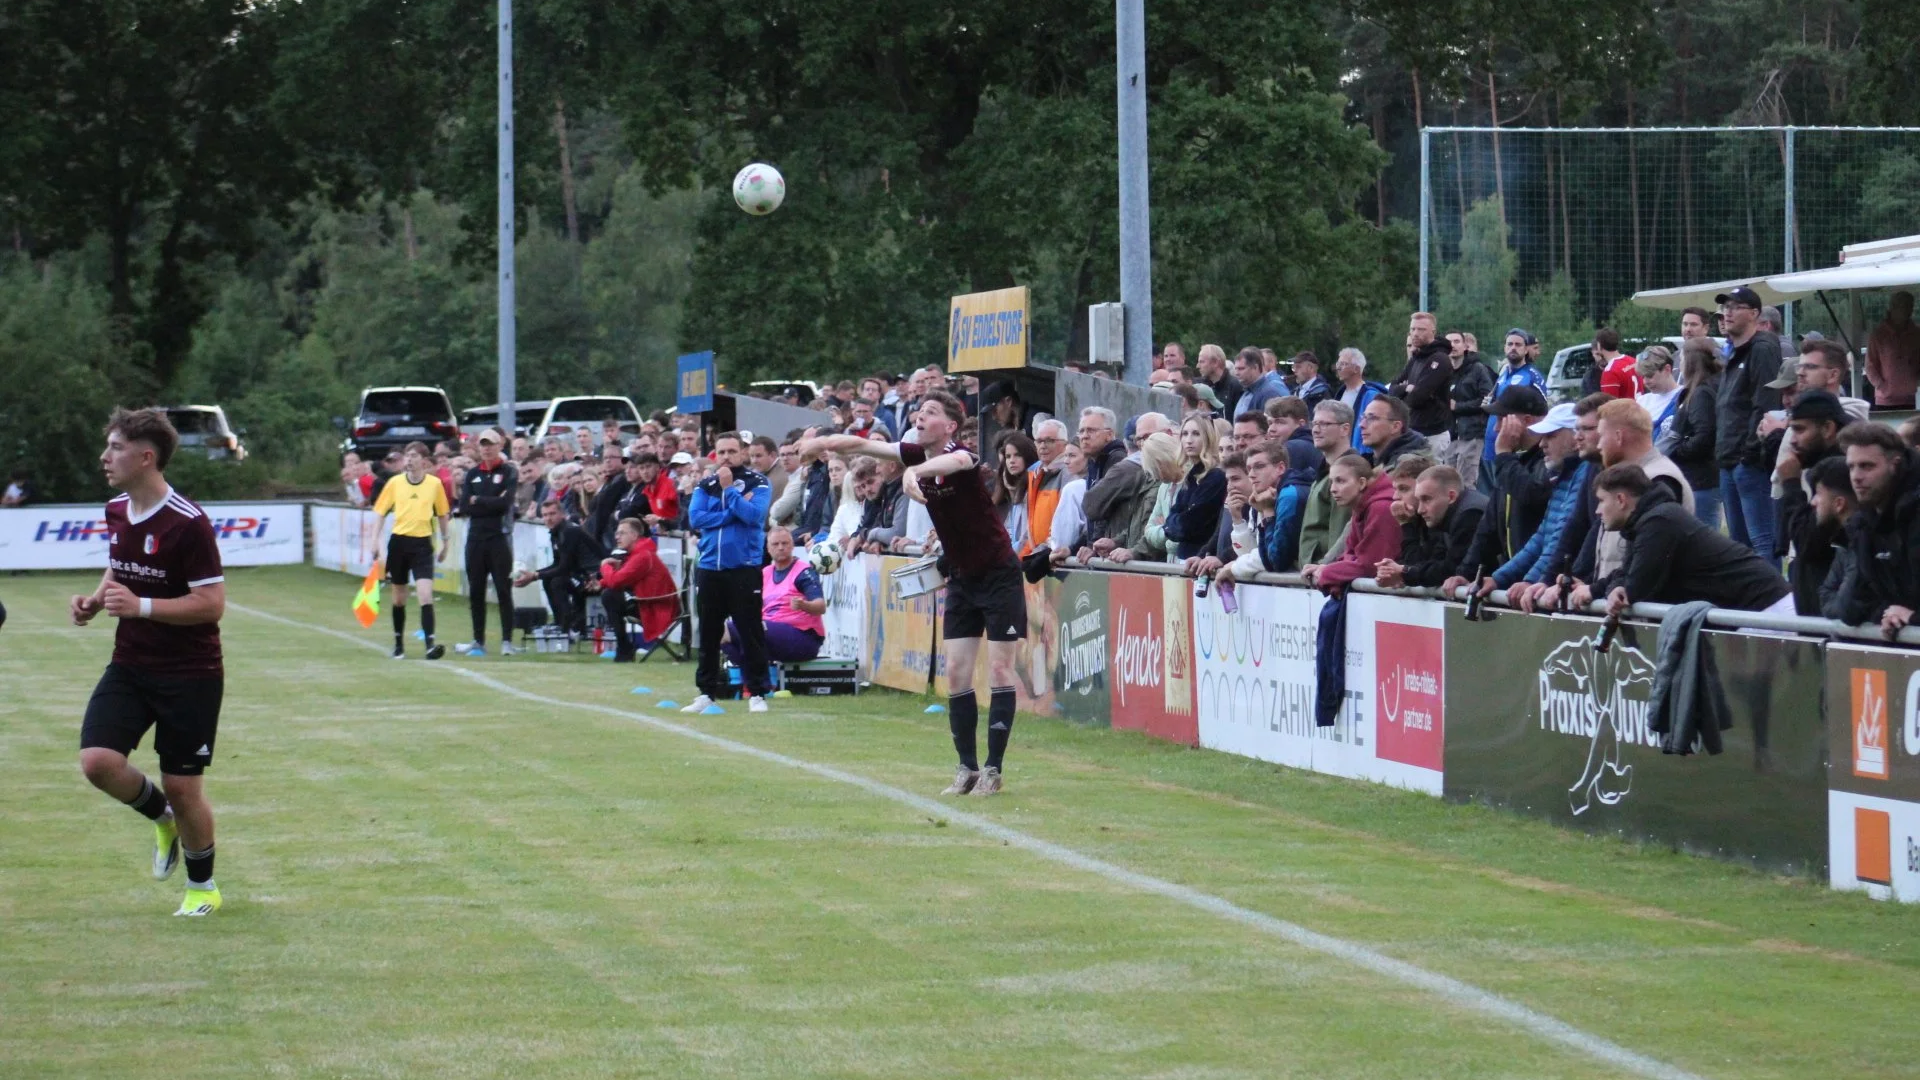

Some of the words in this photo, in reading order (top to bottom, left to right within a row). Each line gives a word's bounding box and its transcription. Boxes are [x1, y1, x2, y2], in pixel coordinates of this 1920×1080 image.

[960, 315, 973, 350] SV
[972, 309, 1023, 349] EDDELSTORF
[34, 520, 111, 542] HiR
[208, 516, 271, 539] iRi
[131, 561, 167, 578] Bytes
[1114, 603, 1161, 708] Hencke
[1269, 622, 1299, 661] KREBS
[1538, 668, 1598, 739] Praxis
[1403, 707, 1433, 734] partner.de
